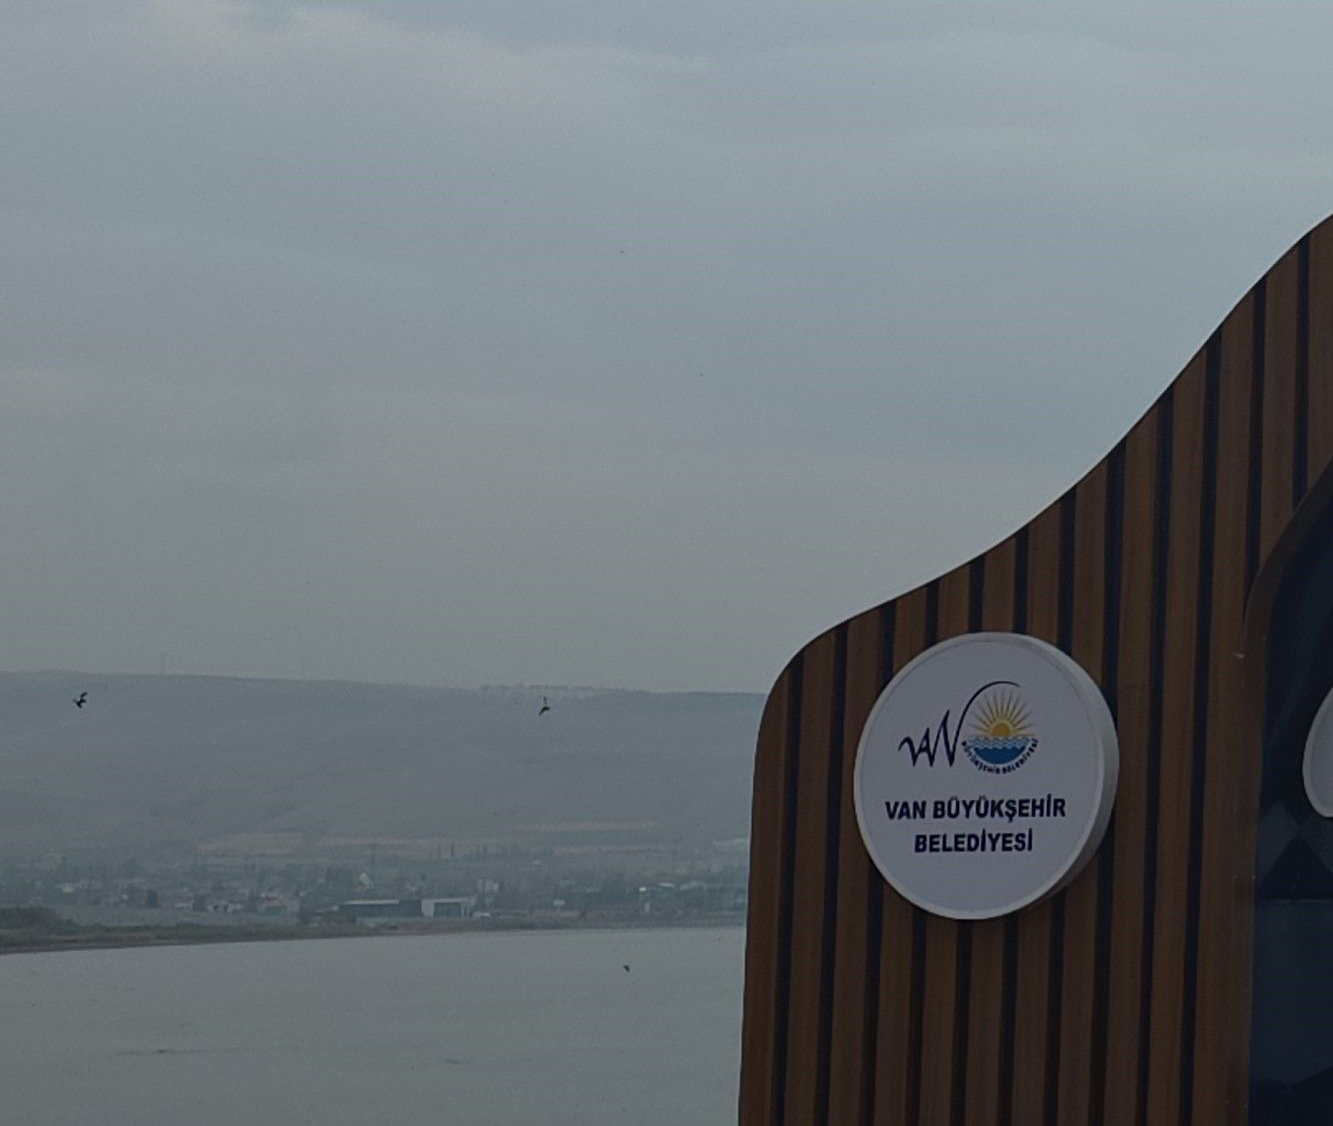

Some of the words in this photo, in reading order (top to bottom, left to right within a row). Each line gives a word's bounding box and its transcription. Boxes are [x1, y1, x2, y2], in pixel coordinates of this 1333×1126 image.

[885, 801, 926, 820] VAN
[933, 794, 1066, 822] BÜYÜKŞEHİR
[914, 828, 1033, 853] BELEDİYESİ
